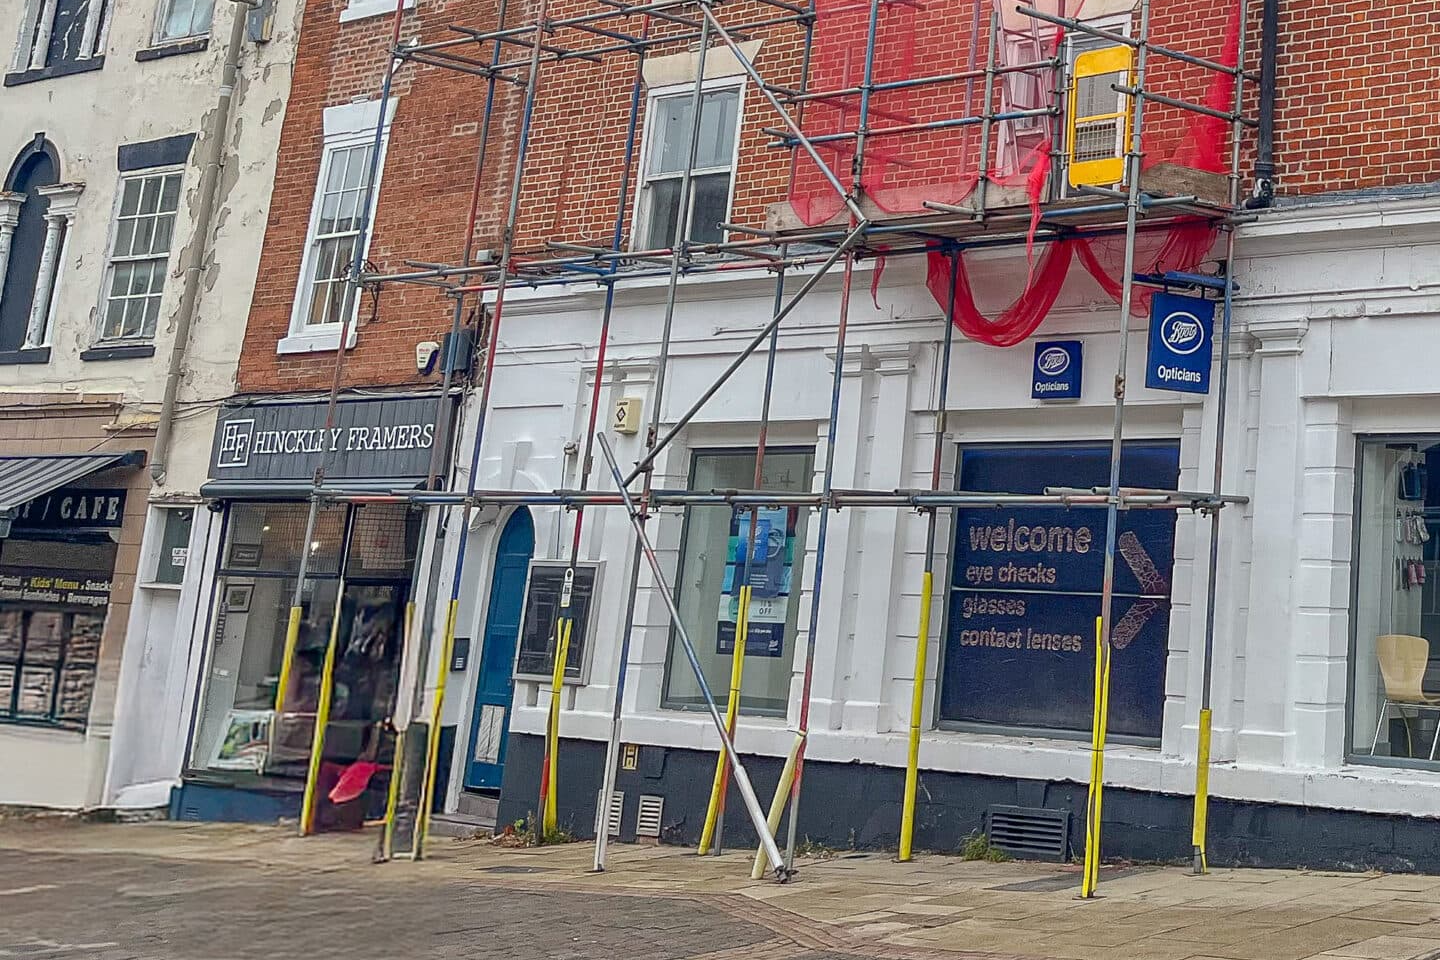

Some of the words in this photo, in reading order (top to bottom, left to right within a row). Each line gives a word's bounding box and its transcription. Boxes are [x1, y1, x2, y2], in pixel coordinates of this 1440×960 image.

[1168, 320, 1198, 344] Boots
[1157, 365, 1202, 383] Opticians
[1034, 380, 1070, 394] Opticians
[345, 424, 436, 452] FRAMERS
[60, 496, 120, 520] CAFE
[968, 517, 1092, 554] welcome
[966, 565, 994, 585] eye
[998, 562, 1056, 584] checks
[759, 607, 773, 615] OFF
[962, 595, 1026, 619] glasses
[960, 626, 1022, 649] contact
[1026, 627, 1082, 653] lenses
